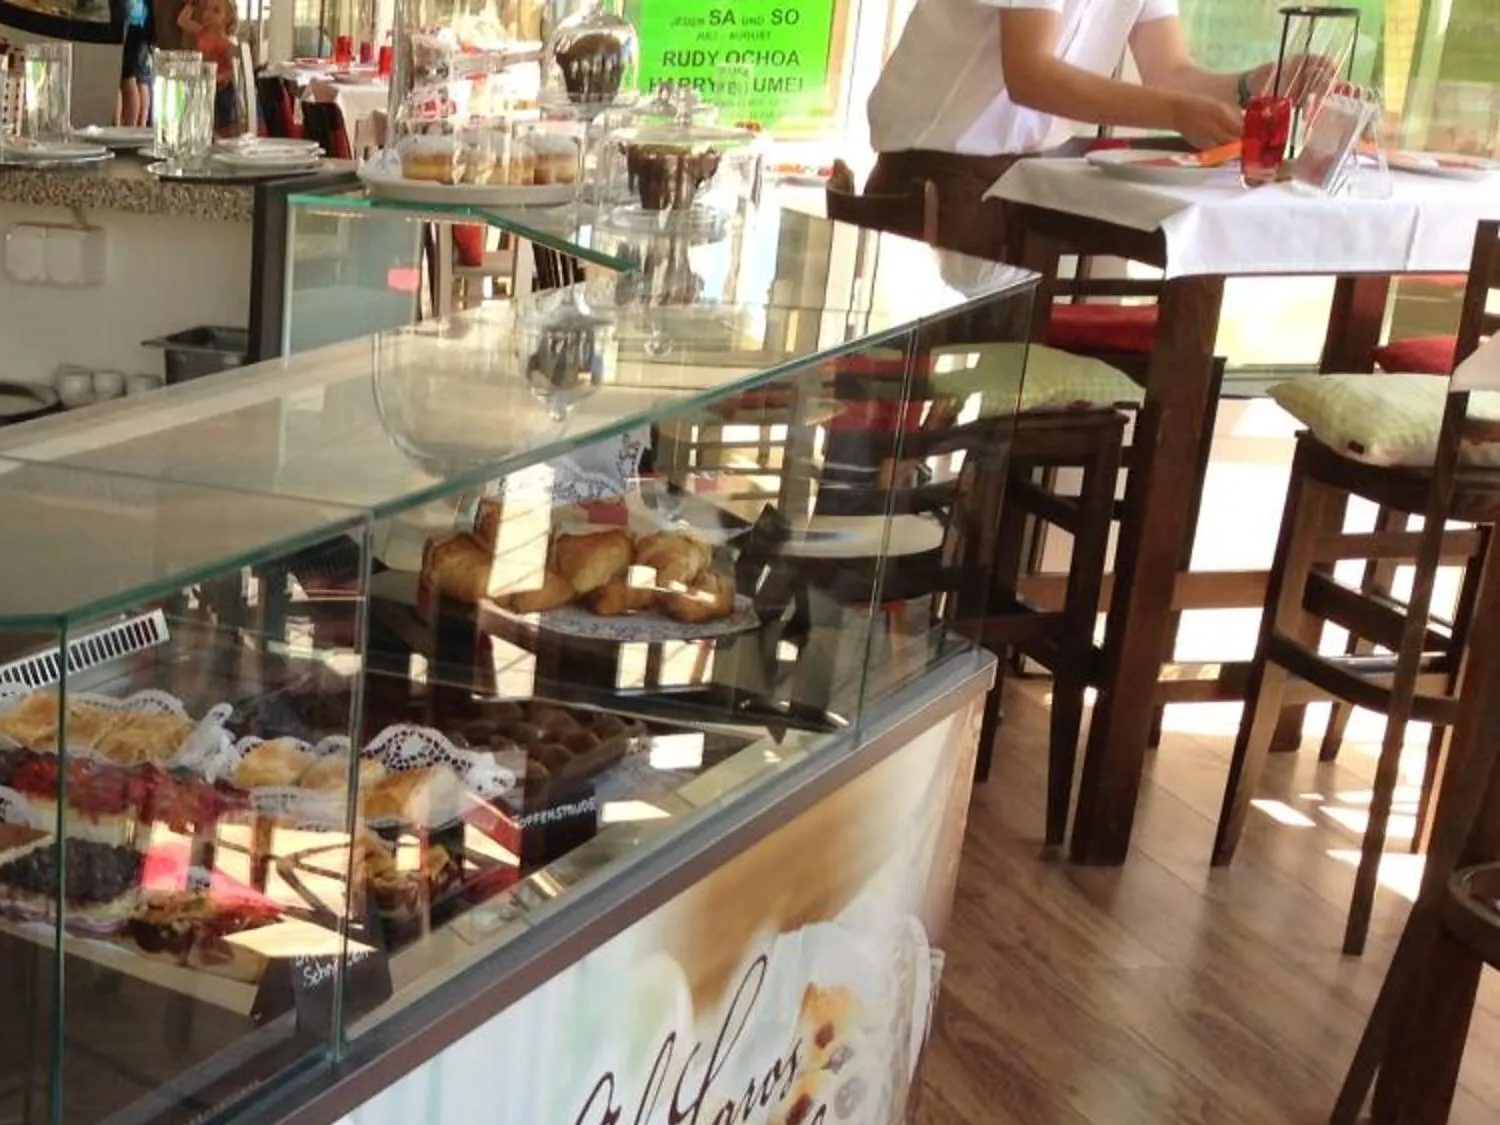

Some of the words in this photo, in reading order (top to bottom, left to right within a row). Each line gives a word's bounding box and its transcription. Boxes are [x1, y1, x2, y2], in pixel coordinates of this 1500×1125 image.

[709, 8, 736, 26] SA
[771, 8, 800, 25] SO
[662, 50, 719, 67] RUDY
[725, 50, 801, 67] OCHOA
